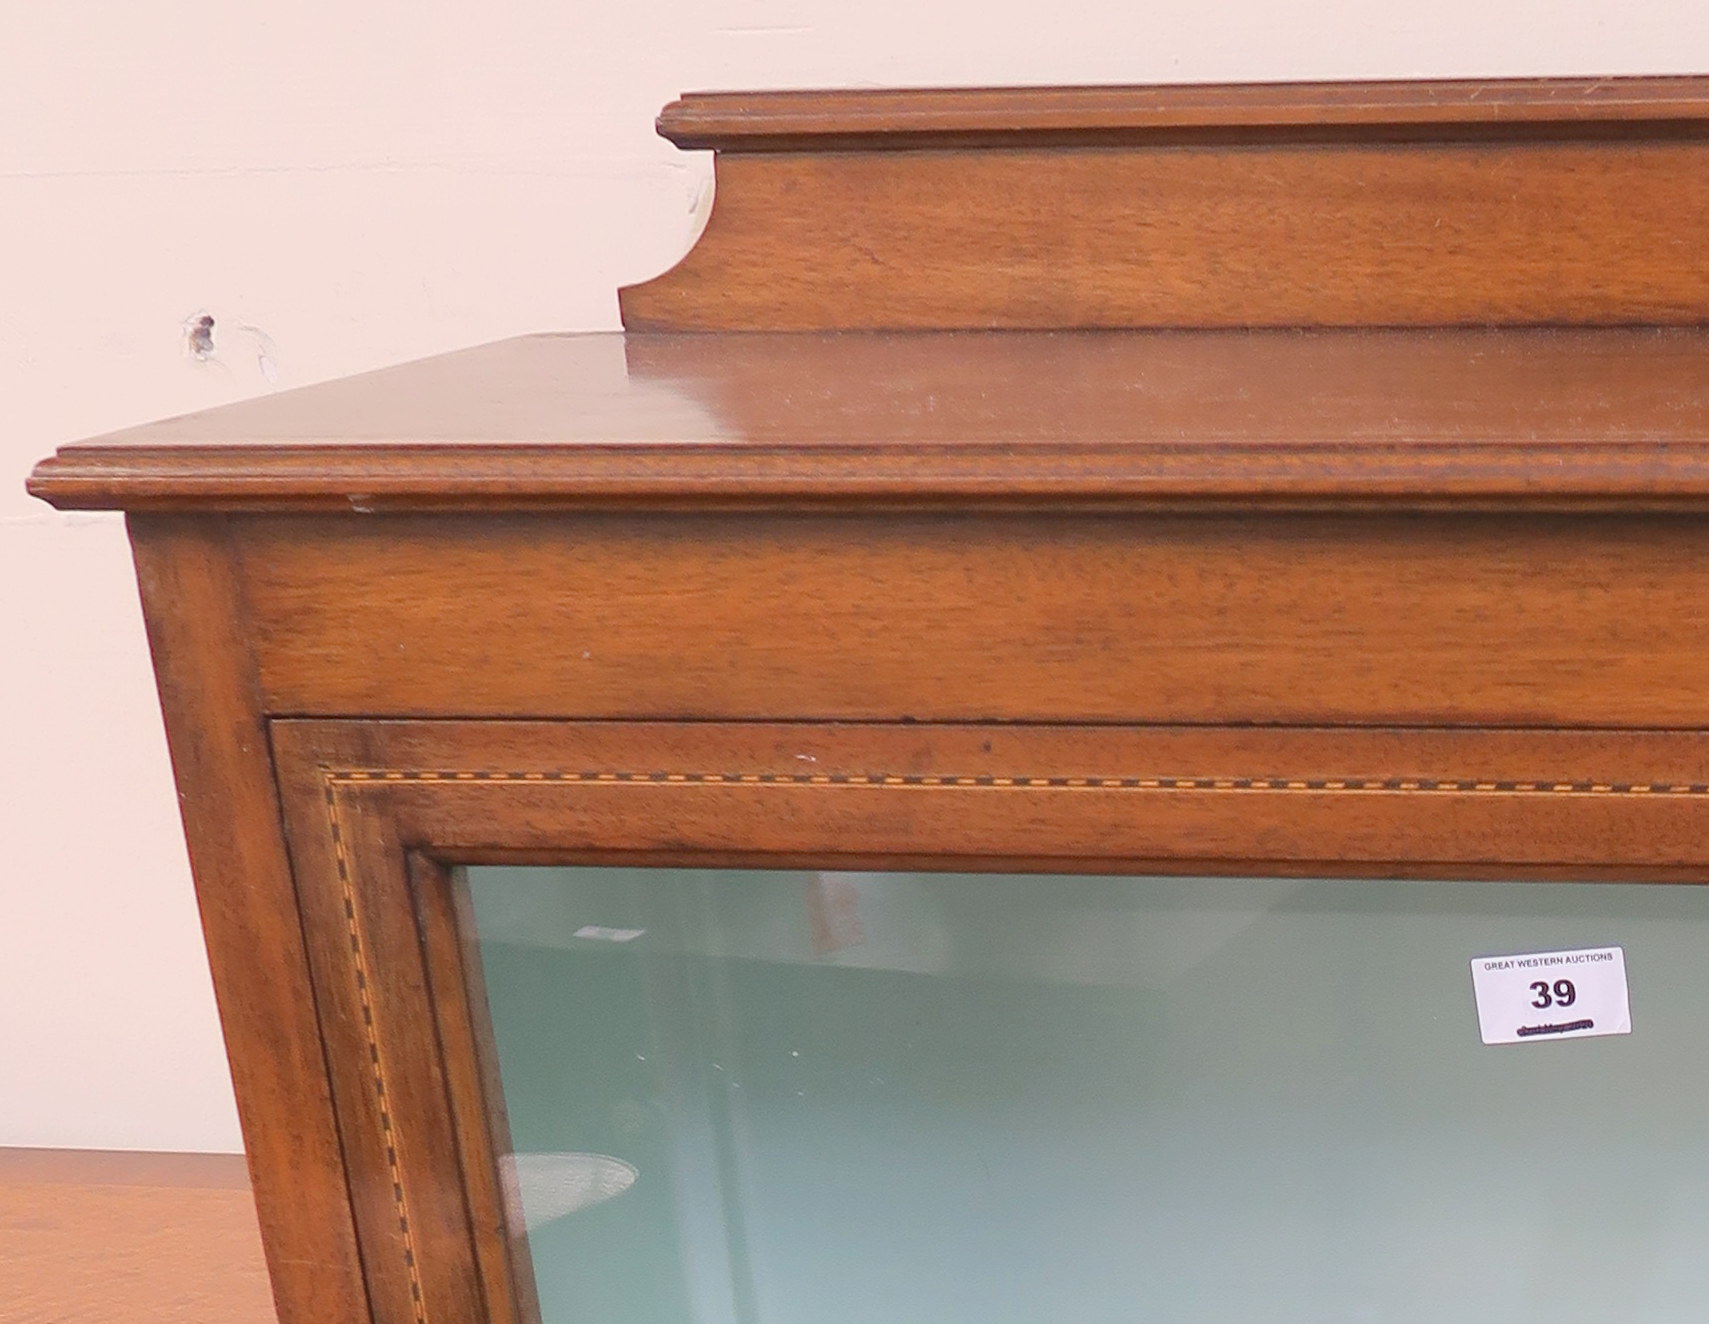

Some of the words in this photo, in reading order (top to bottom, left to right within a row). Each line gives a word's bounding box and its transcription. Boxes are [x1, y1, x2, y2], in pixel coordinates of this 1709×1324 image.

[1484, 960, 1515, 971] GREAT
[1518, 956, 1563, 968] WESTERN
[1565, 952, 1613, 964] AUCTIONS
[1529, 979, 1576, 1009] 39
